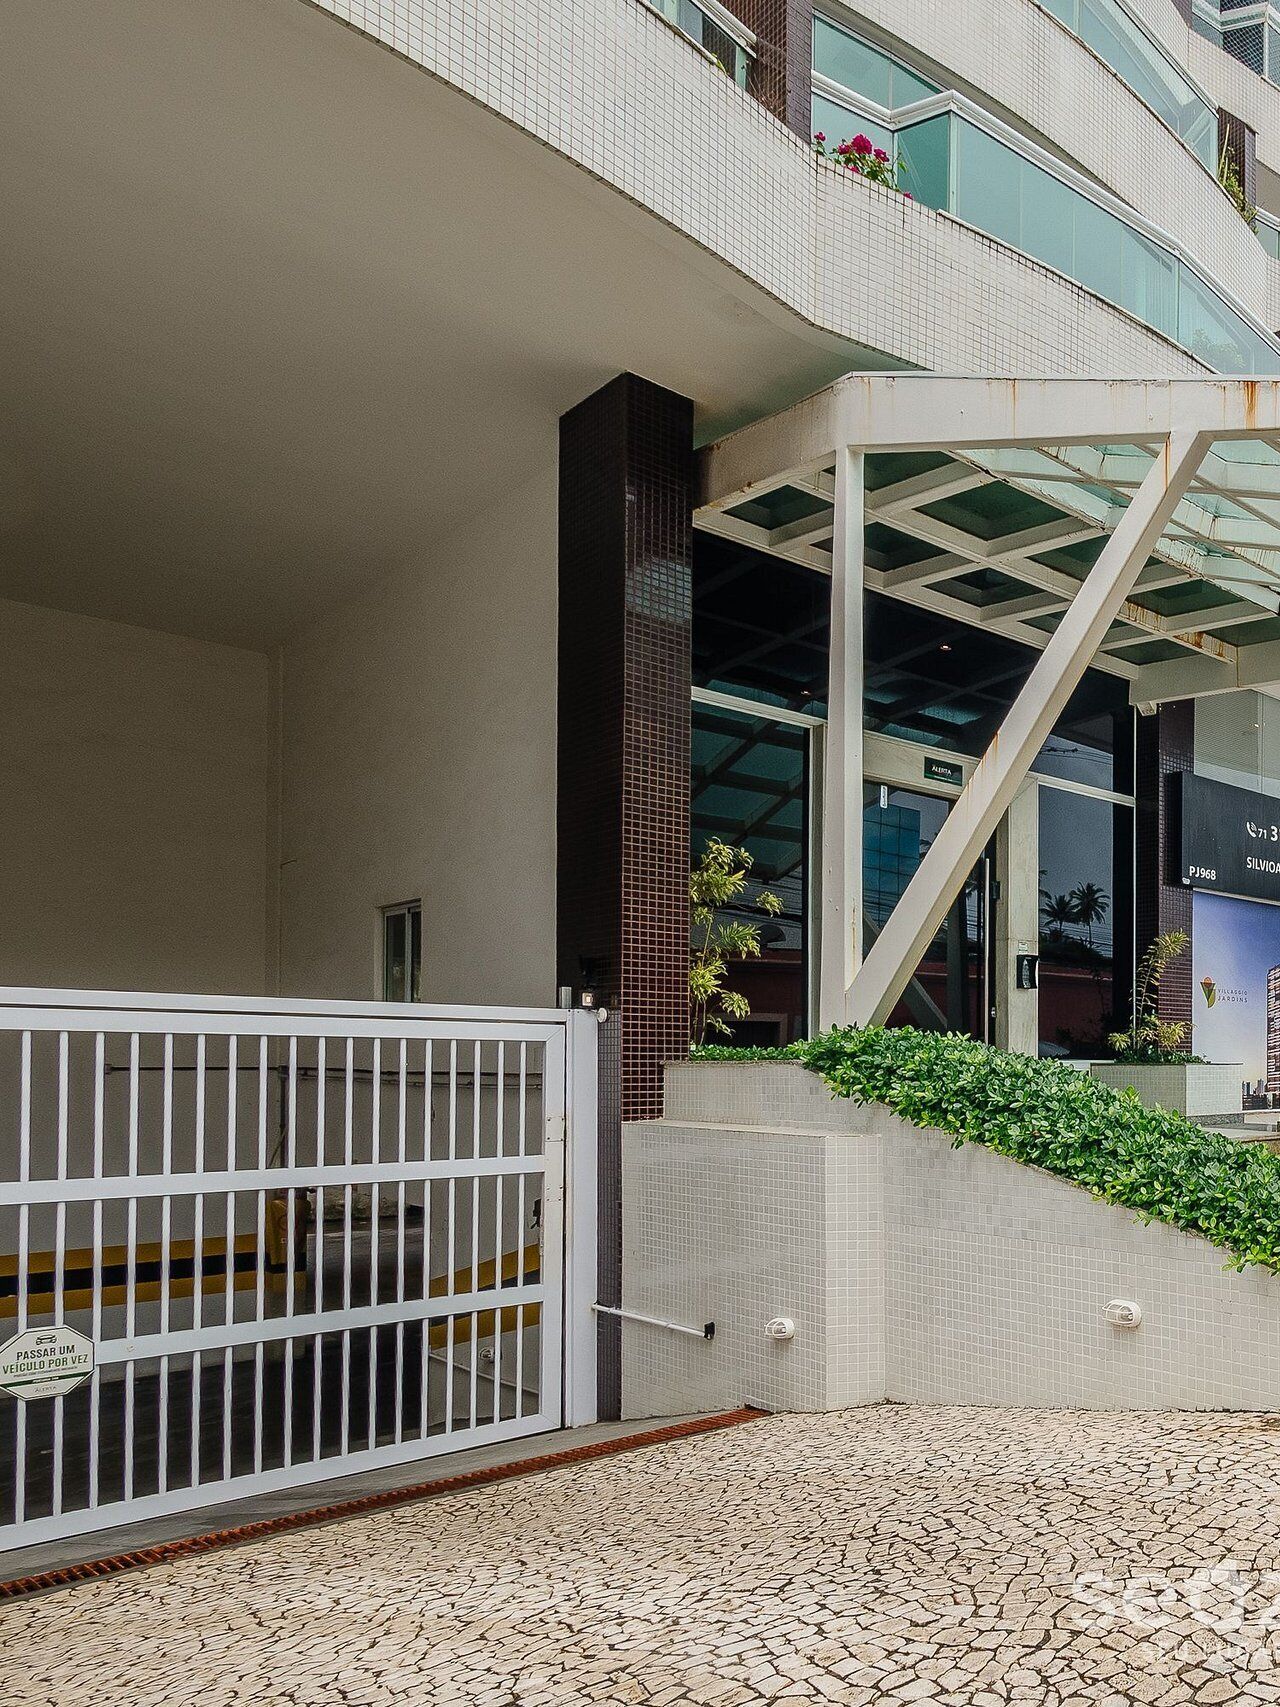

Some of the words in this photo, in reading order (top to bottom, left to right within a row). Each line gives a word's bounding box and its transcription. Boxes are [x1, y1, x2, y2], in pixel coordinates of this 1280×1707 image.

[1257, 828, 1267, 839] 71
[1189, 865, 1217, 881] PJ968
[1217, 988, 1248, 996] VILLAGGIO
[16, 1347, 56, 1361] PASSAR
[59, 1345, 75, 1356] UM
[2, 1360, 45, 1374] VEÍCULO
[48, 1356, 68, 1368] POR
[71, 1354, 89, 1364] VEZ
